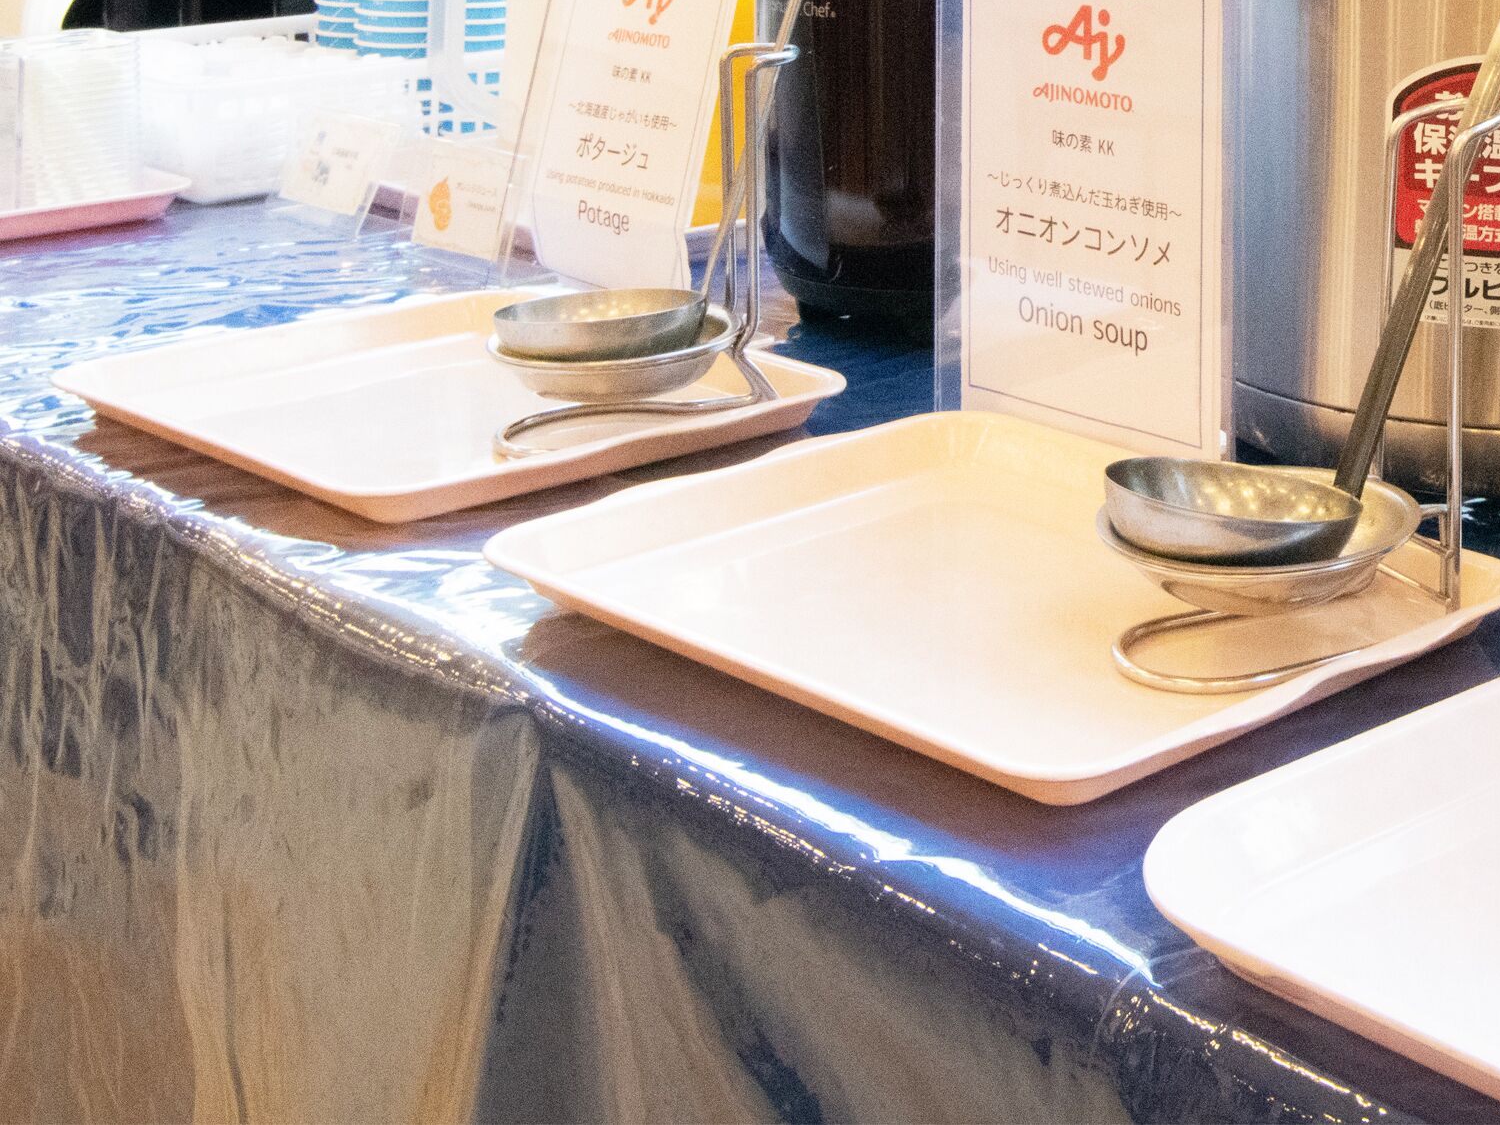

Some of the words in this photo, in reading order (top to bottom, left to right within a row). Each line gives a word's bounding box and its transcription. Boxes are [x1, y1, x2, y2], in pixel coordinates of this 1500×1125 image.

[608, 28, 671, 49] AJINOMOTO
[612, 65, 637, 83] 味の素
[1032, 82, 1133, 113] AJINOMOTO
[576, 133, 649, 170] ポタージュ
[1052, 129, 1092, 154] 味の素
[1098, 139, 1115, 157] KK
[577, 199, 630, 236] Potage
[996, 206, 1171, 266] オニオンコンソメ
[988, 255, 1027, 284] Using
[1033, 269, 1062, 289] well
[1068, 276, 1124, 303] stewed
[1130, 292, 1182, 317] onions
[1018, 296, 1083, 335] Onion
[1093, 319, 1148, 356] soup
